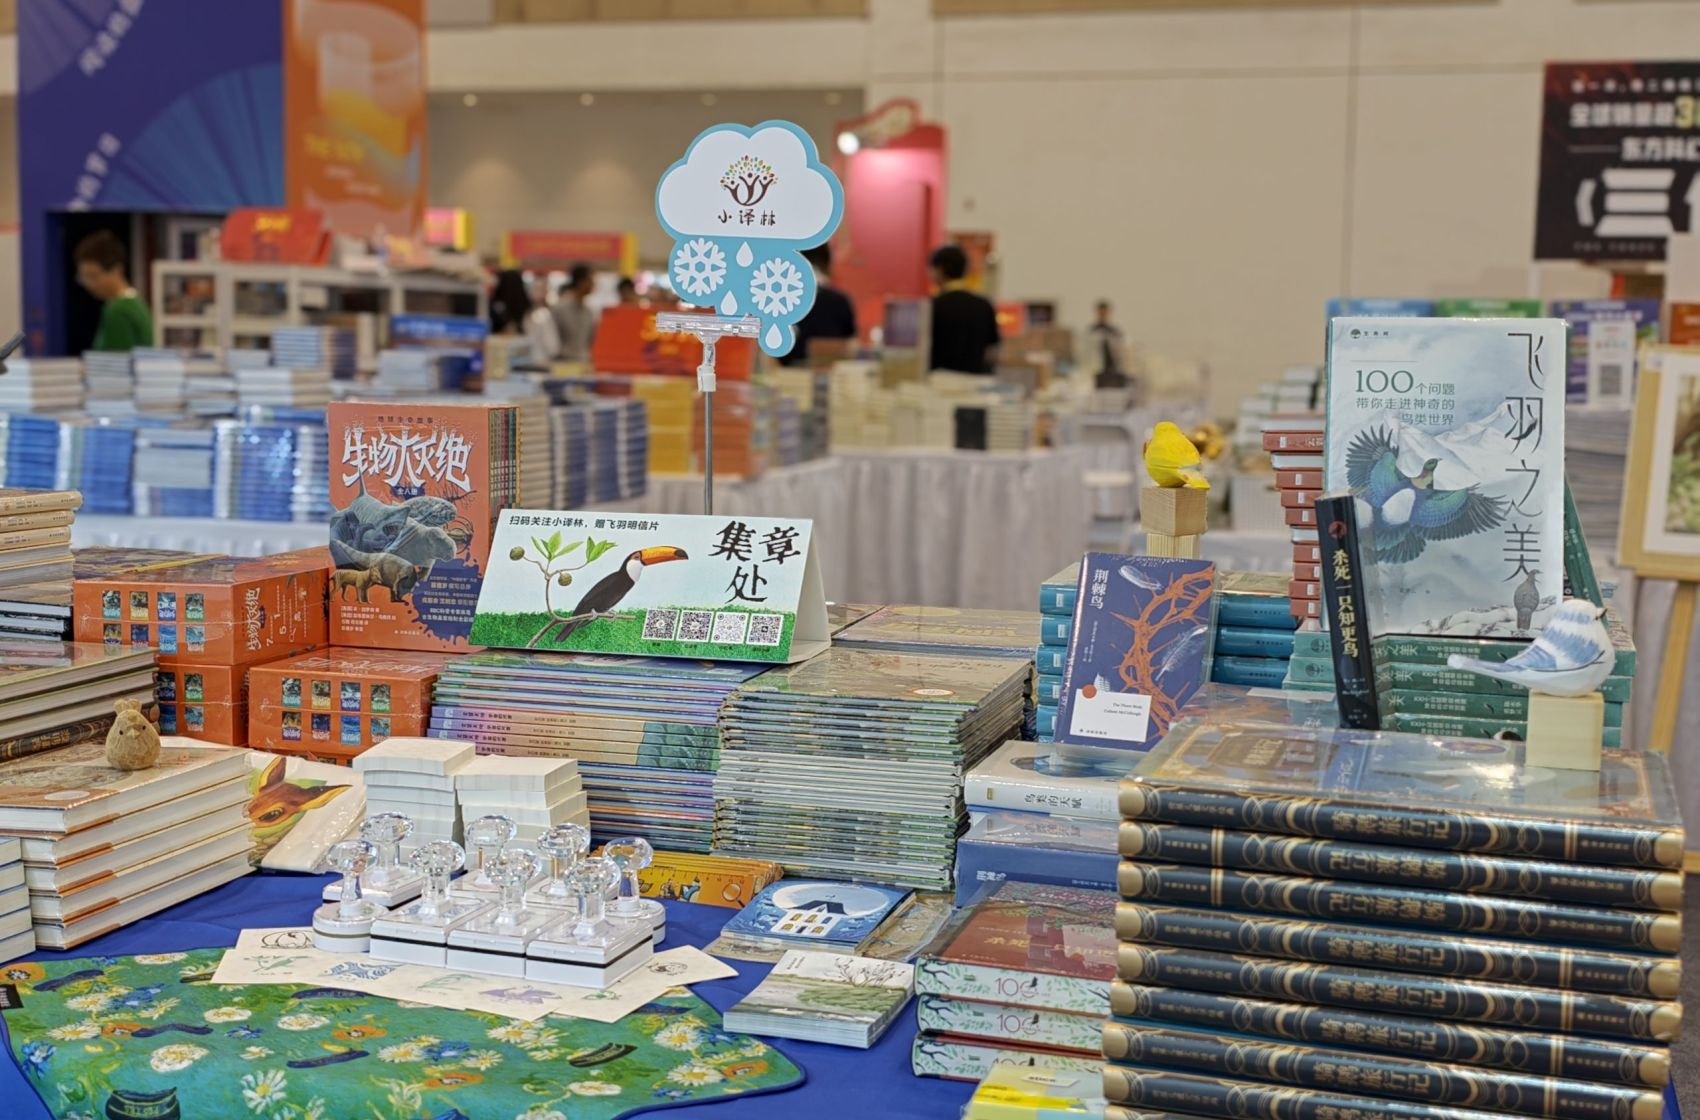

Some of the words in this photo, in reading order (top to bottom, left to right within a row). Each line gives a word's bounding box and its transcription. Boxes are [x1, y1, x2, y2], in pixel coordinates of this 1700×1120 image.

[717, 207, 777, 227] 小译林
[1355, 369, 1456, 396] 100个问题
[1355, 397, 1456, 411] 带你走进神奇的
[1400, 412, 1456, 427] 鸟类世界
[341, 426, 474, 493] 生物大灭绝
[1503, 332, 1545, 583] 飞羽之美
[508, 515, 660, 532] 扫码关注小译林，赠飞羽明信片
[708, 519, 801, 566] 集章
[725, 564, 769, 605] 处
[1089, 568, 1110, 610] 荆棘鸟
[1332, 548, 1360, 659] 杀死一只知更鸟
